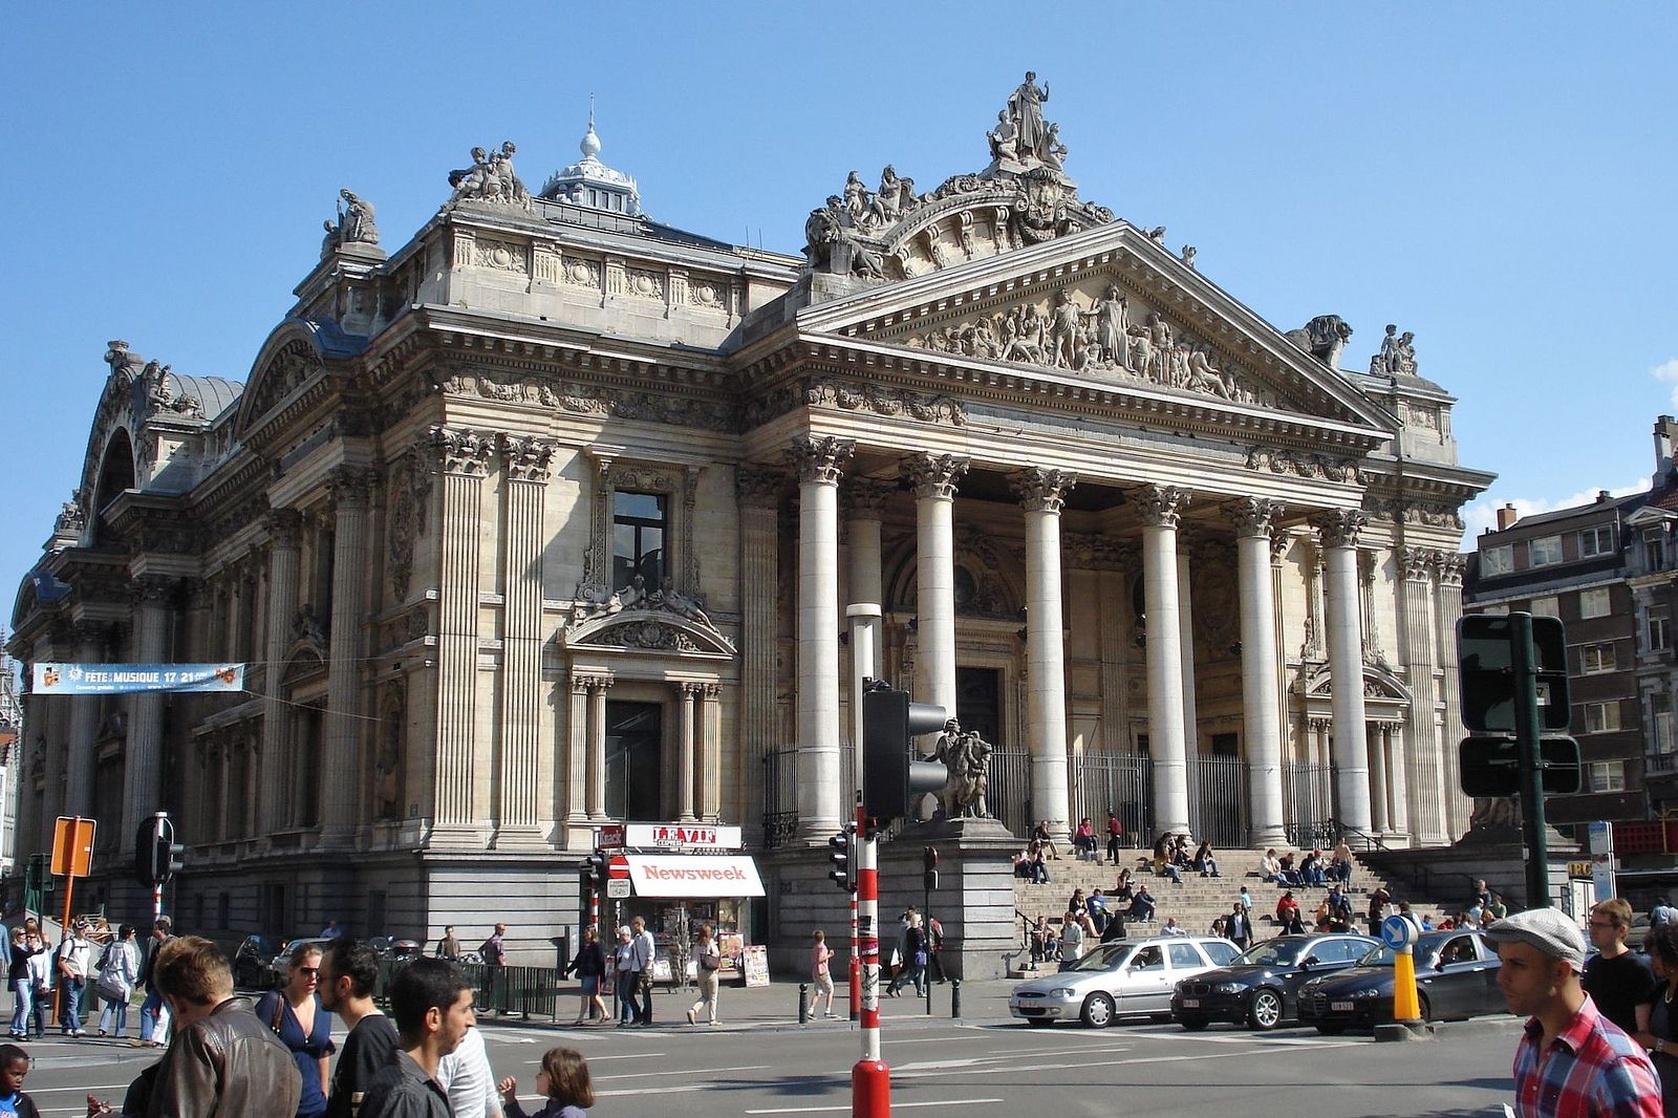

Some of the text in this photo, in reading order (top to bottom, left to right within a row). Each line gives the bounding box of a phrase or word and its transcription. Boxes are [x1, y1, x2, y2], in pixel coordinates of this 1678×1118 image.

[113, 672, 160, 683] MUSIQUE
[164, 672, 177, 683] 17
[181, 672, 194, 683] 21
[642, 865, 747, 880] Newsweek
